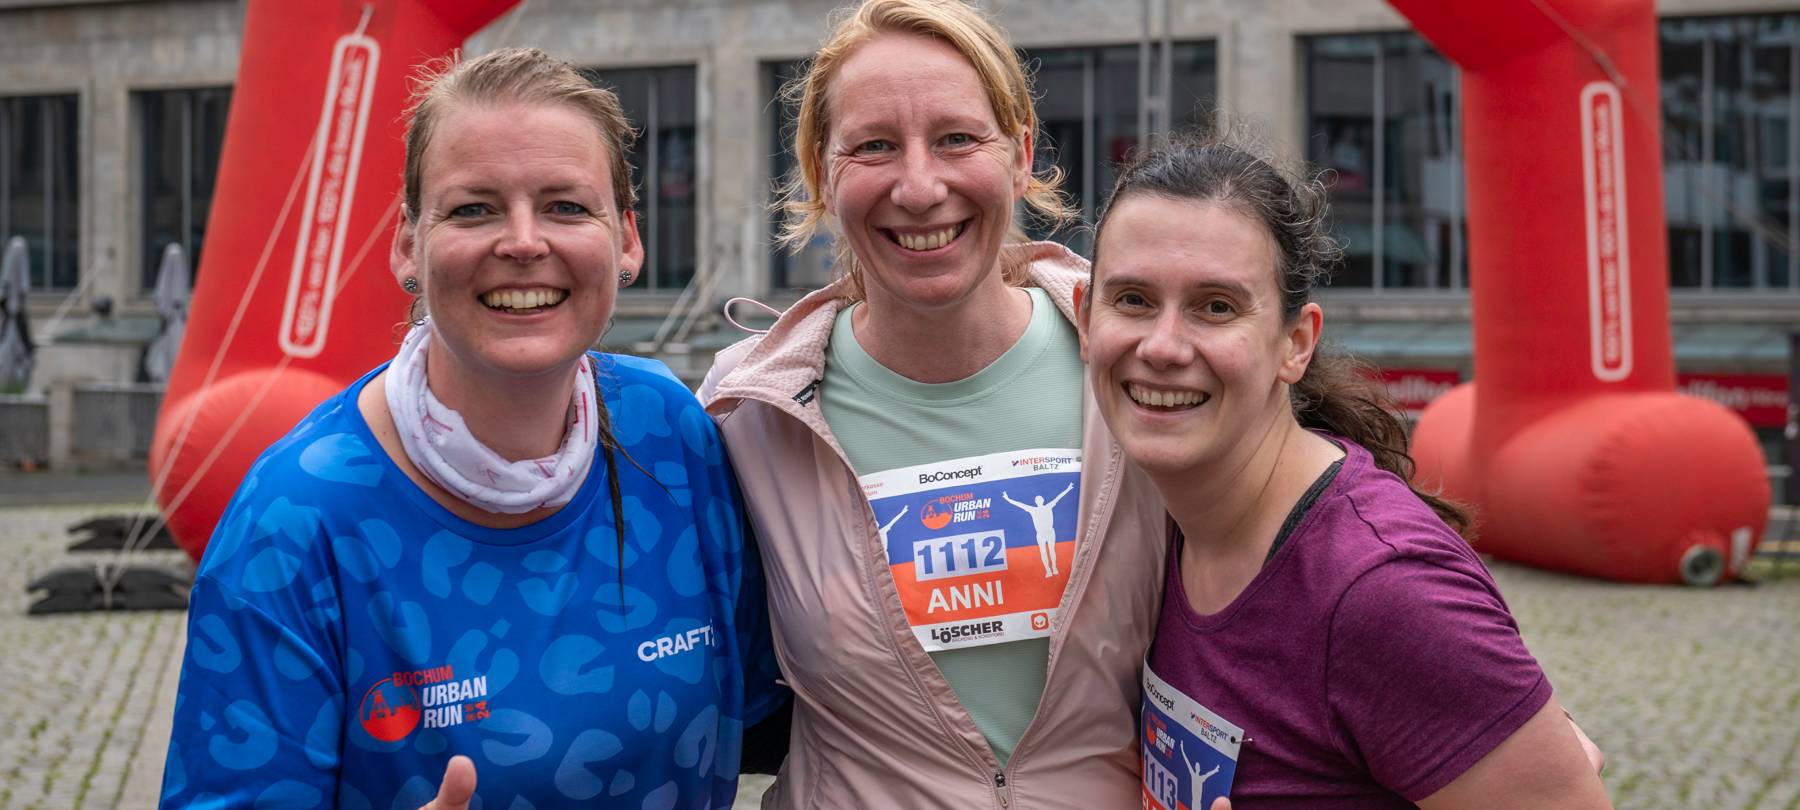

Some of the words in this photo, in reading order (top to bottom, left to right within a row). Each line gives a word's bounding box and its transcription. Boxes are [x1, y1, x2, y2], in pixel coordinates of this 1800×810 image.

[1020, 457, 1072, 465] INTERSPORT
[919, 466, 982, 484] BoConcept
[940, 492, 974, 504] BOCHUM
[953, 498, 991, 513] URBAN
[953, 510, 976, 523] RUN
[917, 536, 1004, 574] 1112
[928, 580, 1003, 613] ANNI
[637, 625, 711, 661] CRAFT
[931, 621, 1003, 643] LÖSCHER
[393, 664, 454, 687] BOCHUM
[422, 676, 487, 707] URBAN
[424, 704, 463, 728] RUN
